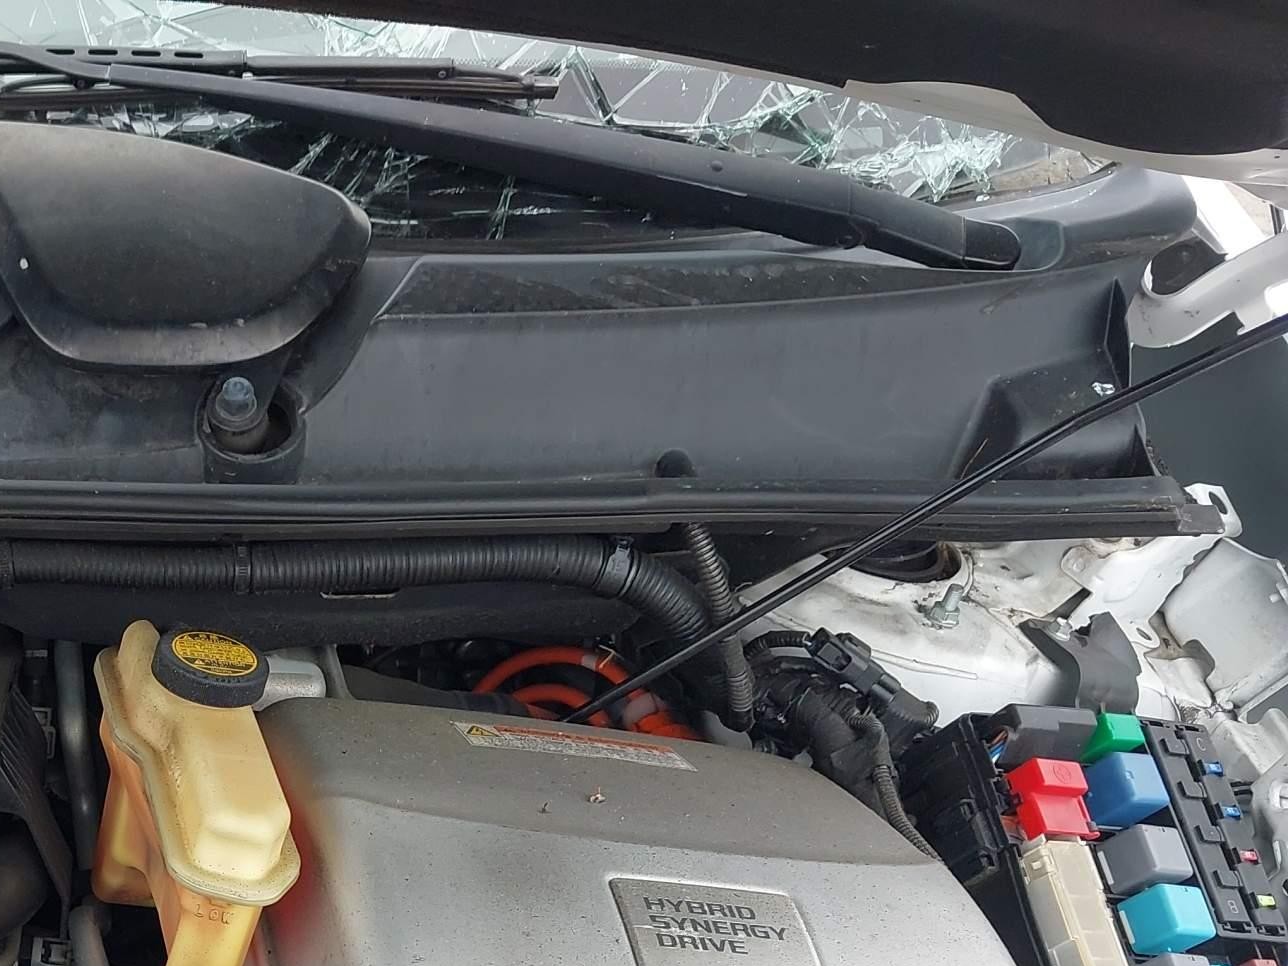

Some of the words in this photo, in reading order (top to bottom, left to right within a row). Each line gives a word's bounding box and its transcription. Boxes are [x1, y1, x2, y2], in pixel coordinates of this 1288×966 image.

[642, 897, 756, 920] HYBRID
[648, 915, 787, 941] SYNERGY
[655, 932, 749, 955] DRIVE
